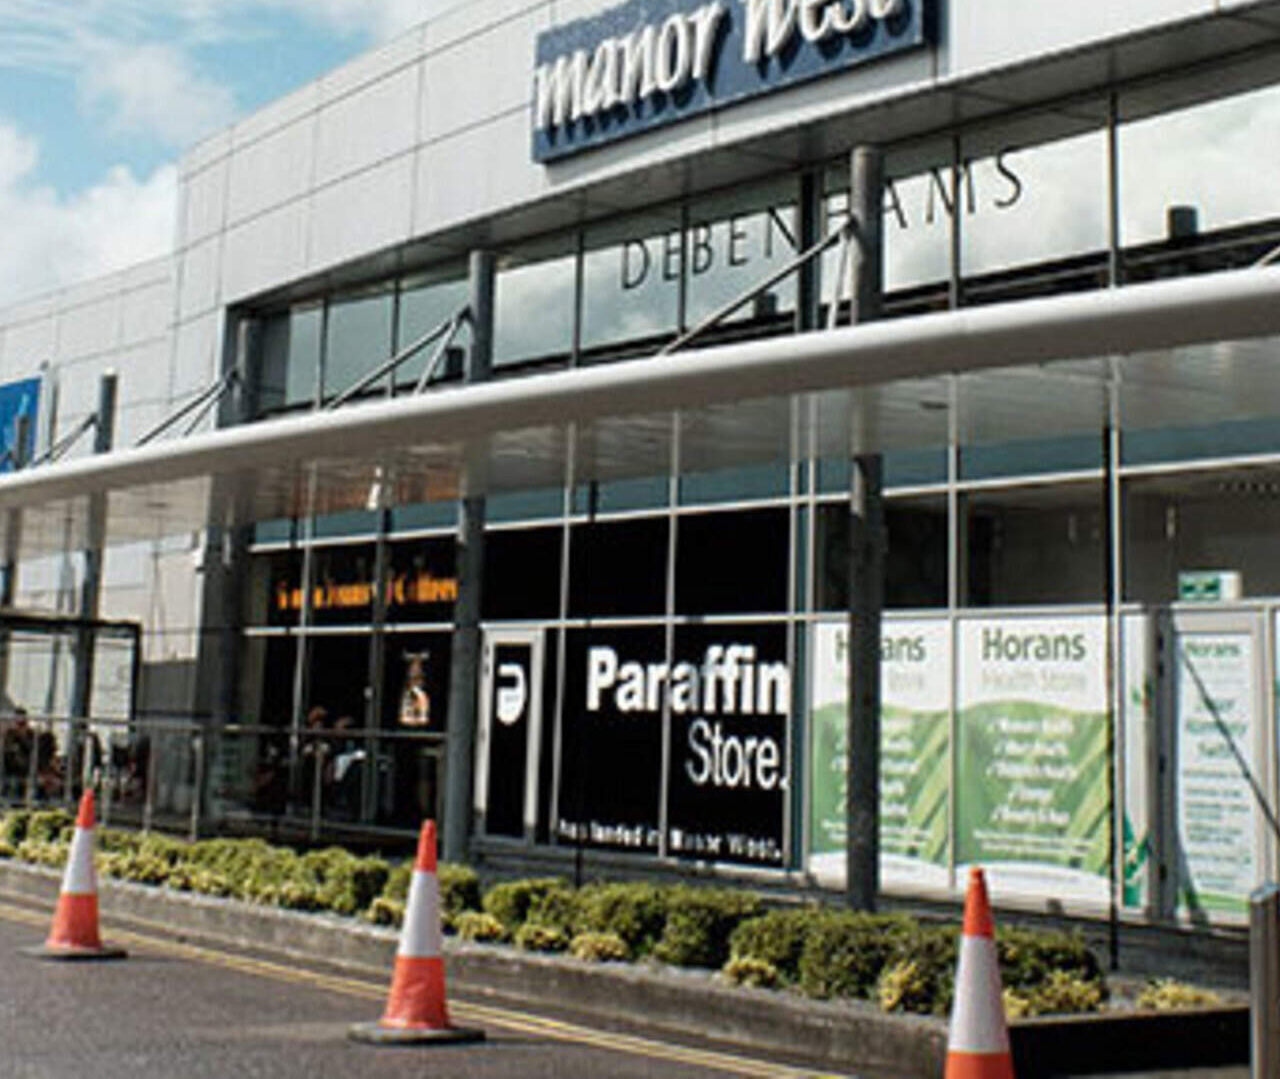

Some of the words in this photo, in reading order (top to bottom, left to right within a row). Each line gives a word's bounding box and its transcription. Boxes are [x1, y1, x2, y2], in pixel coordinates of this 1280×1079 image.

[535, 3, 728, 125] manor
[586, 645, 790, 715] Paraffin
[835, 630, 926, 662] Hans
[981, 628, 1087, 663] Horans
[685, 717, 789, 790] Store.
